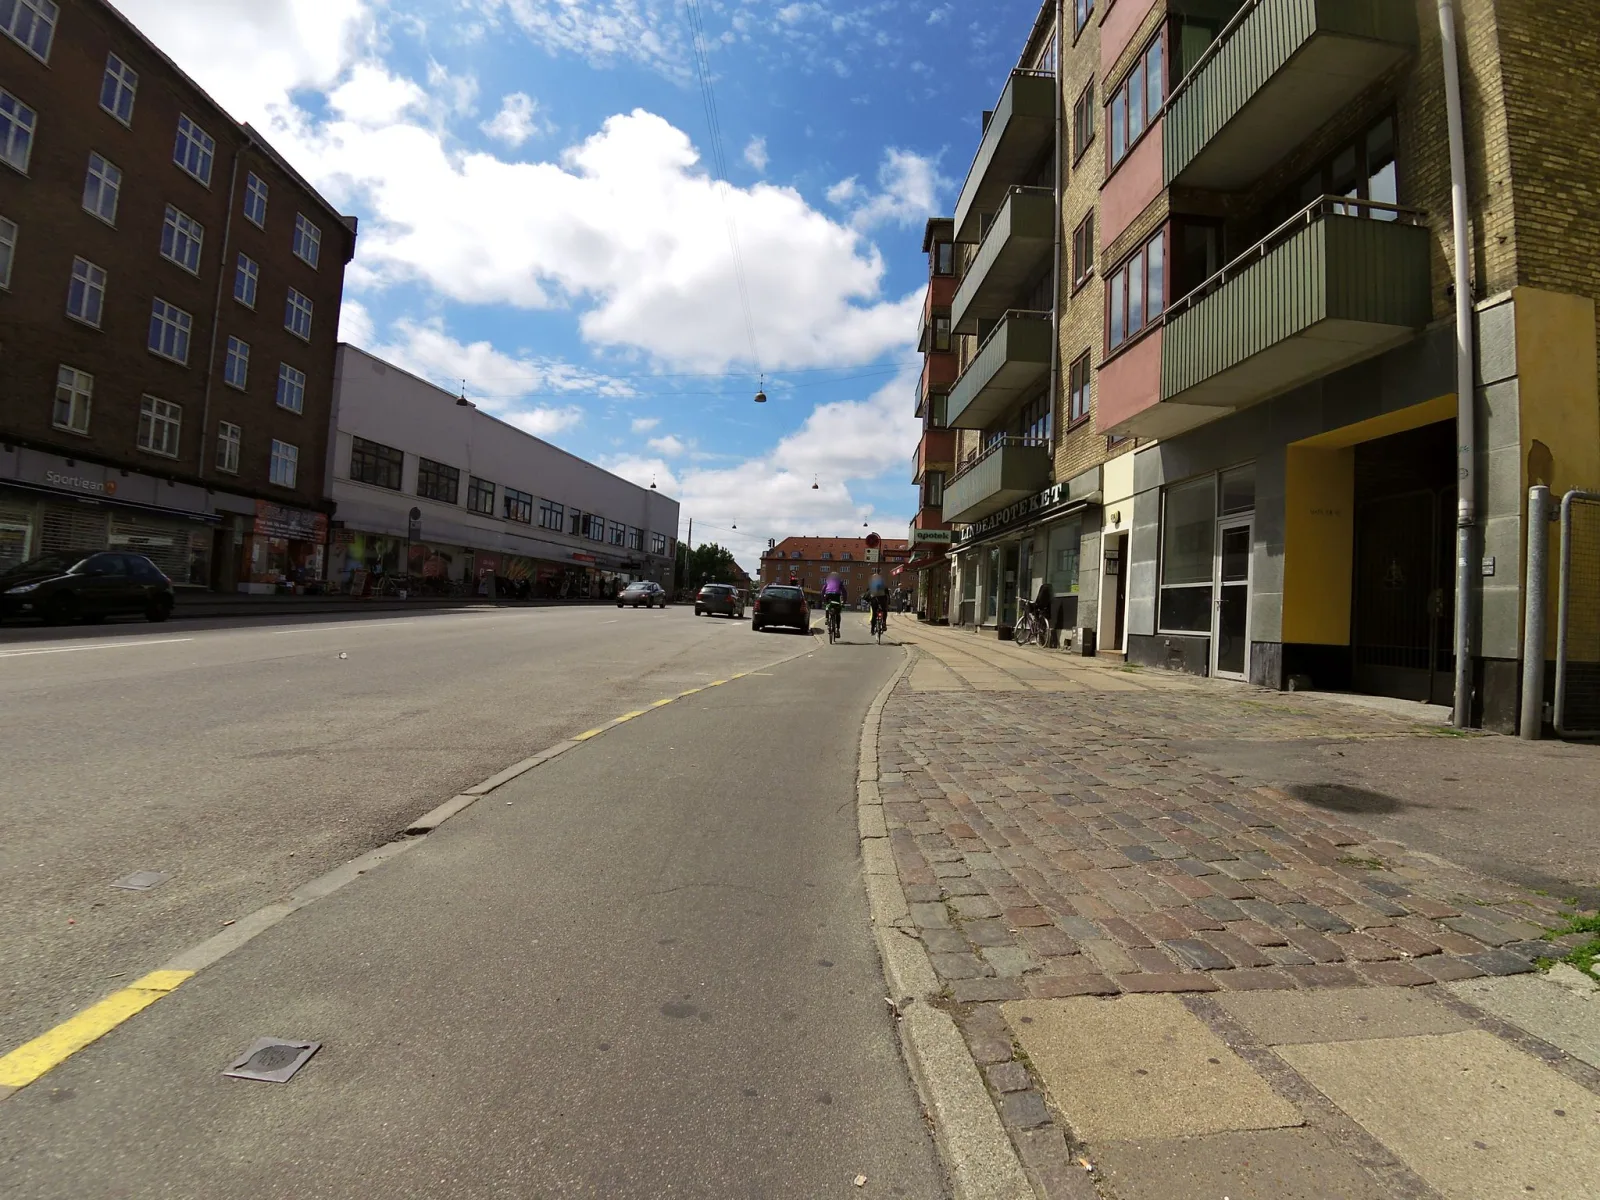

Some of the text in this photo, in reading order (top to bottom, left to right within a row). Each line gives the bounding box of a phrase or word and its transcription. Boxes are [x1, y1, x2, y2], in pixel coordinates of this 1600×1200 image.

[46, 470, 104, 491] Sportigan
[960, 483, 1062, 541] LINDEAPOTEKET
[917, 531, 949, 540] apotek
